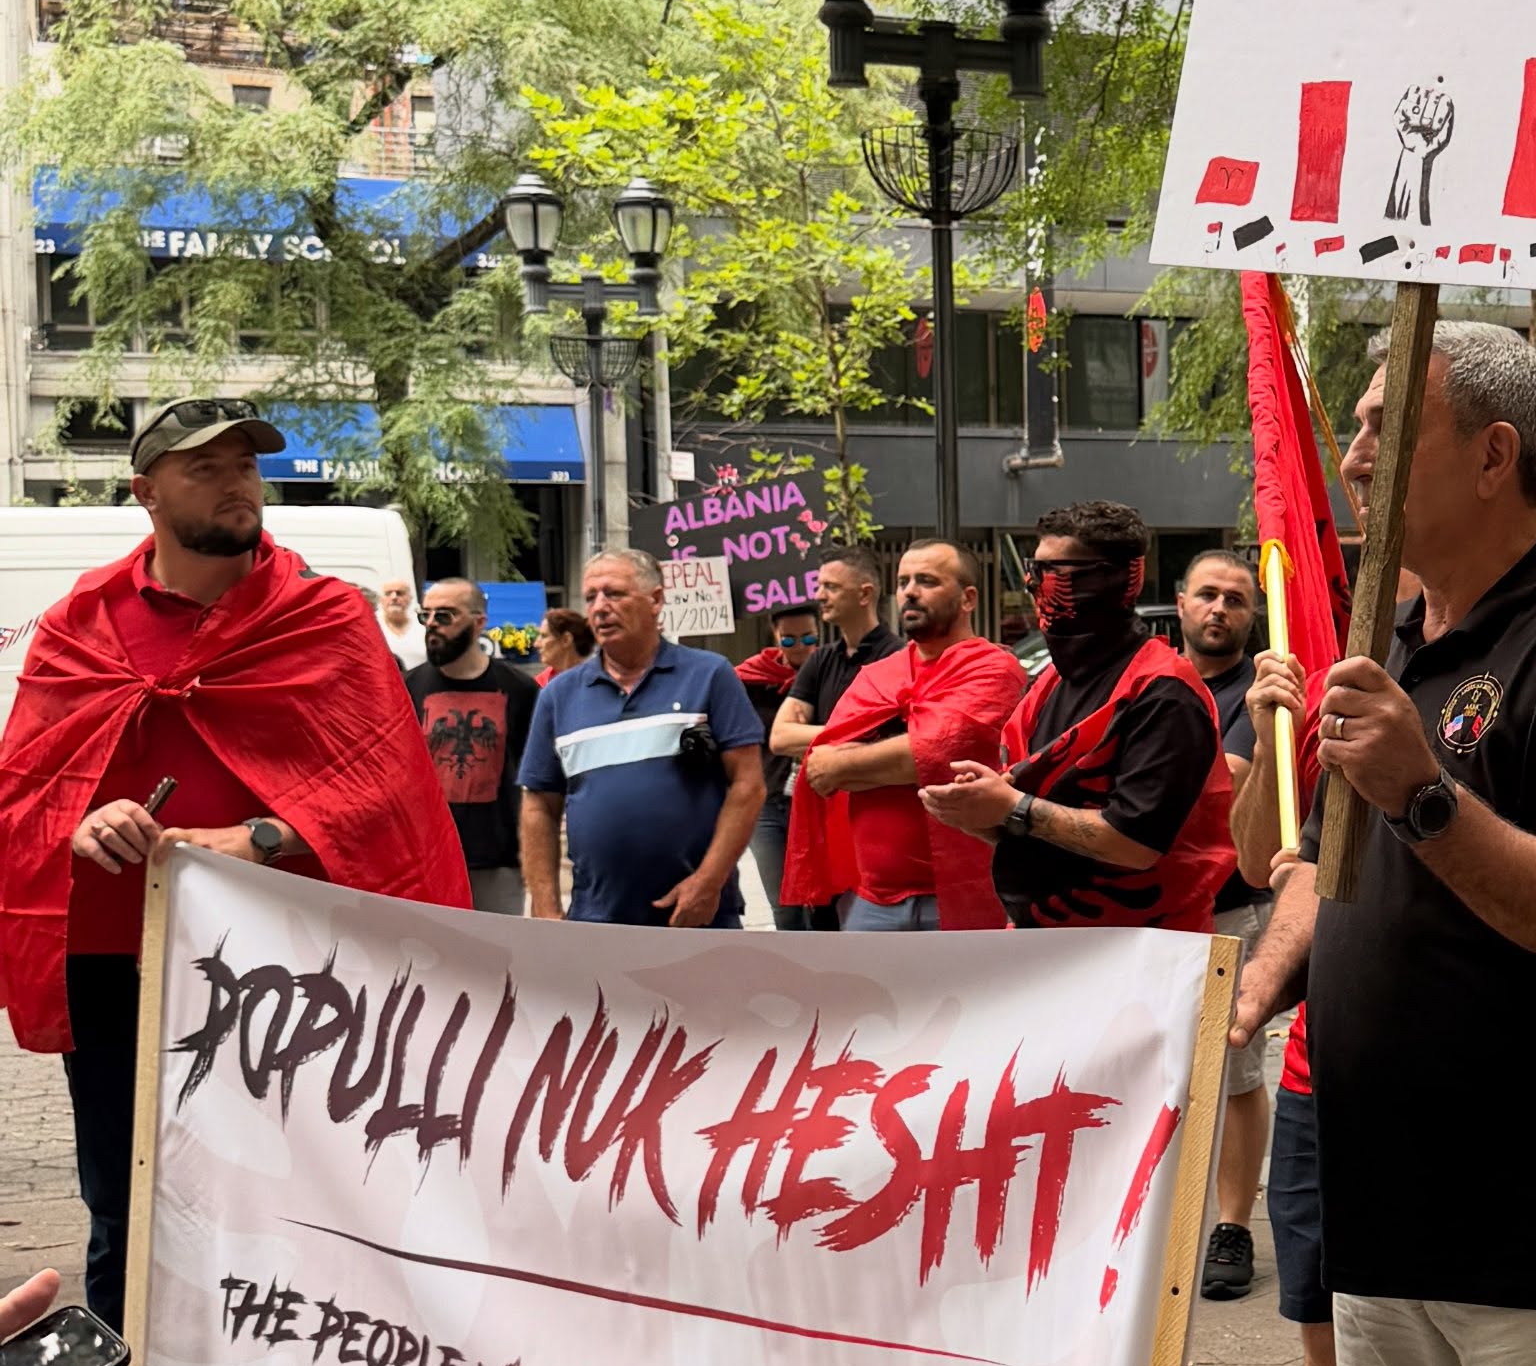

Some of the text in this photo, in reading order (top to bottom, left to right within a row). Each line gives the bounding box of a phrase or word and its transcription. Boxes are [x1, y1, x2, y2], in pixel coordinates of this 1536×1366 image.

[34, 238, 56, 253] 23
[664, 481, 807, 535] ALBANIA
[722, 525, 791, 565] NOT
[661, 561, 721, 589] EPEAL
[744, 570, 820, 613] SALE
[162, 928, 518, 1197] POPULLI
[501, 980, 725, 1227] NUK
[220, 1272, 309, 1346] THE
